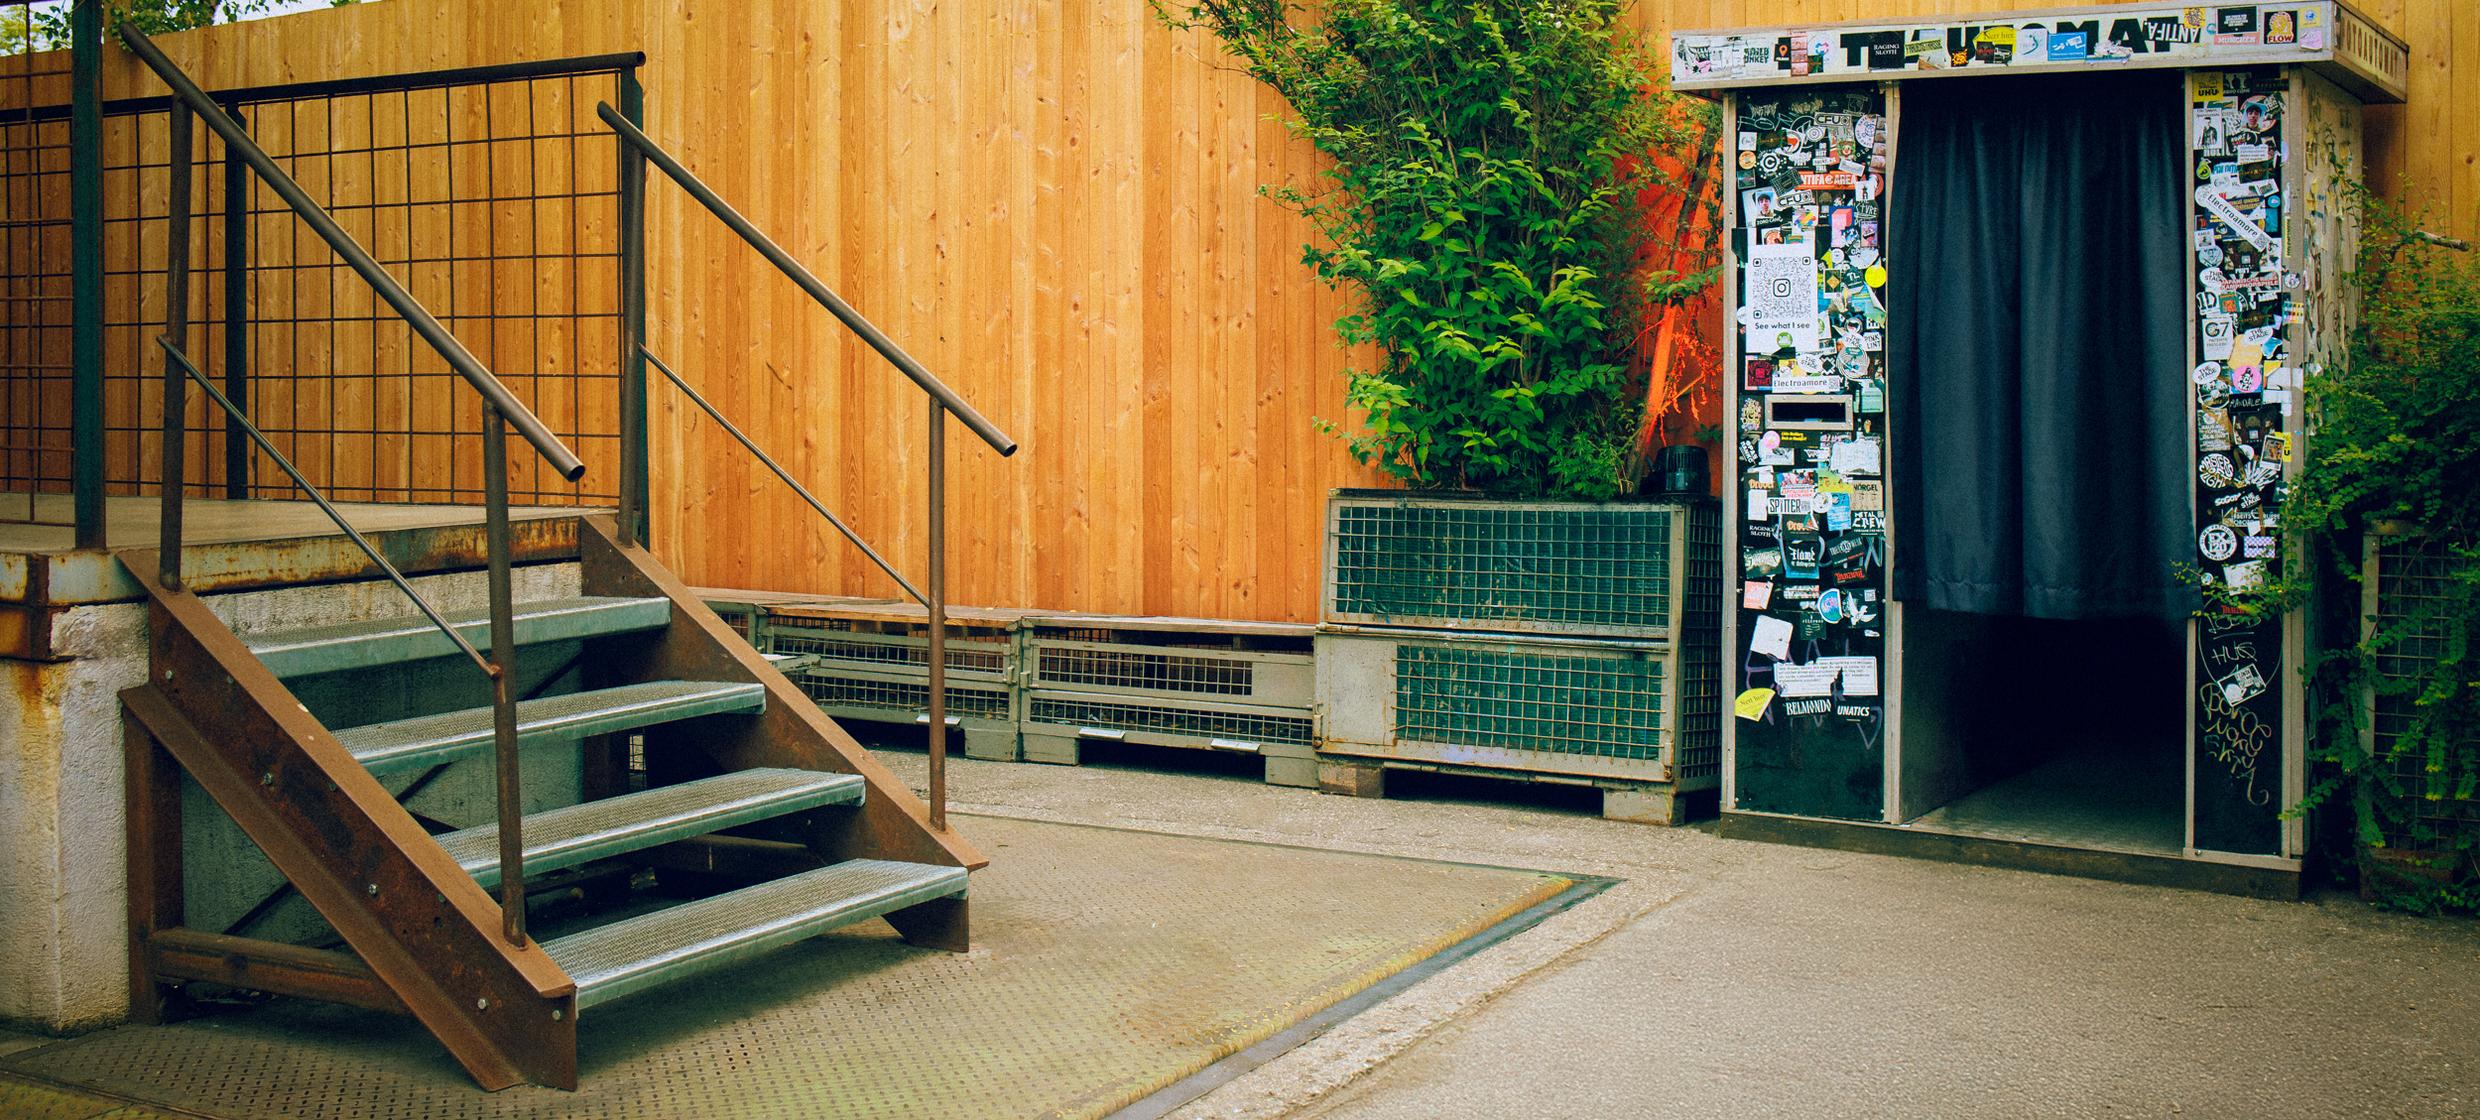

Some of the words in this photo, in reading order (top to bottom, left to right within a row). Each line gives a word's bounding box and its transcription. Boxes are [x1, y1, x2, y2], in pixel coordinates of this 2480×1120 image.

[2268, 35, 2293, 43] FLOW
[1873, 43, 1900, 51] RAGING
[1755, 322, 1769, 330] See
[1770, 321, 1791, 330] what
[2205, 321, 2229, 338] G7
[1852, 517, 1886, 529] CREW
